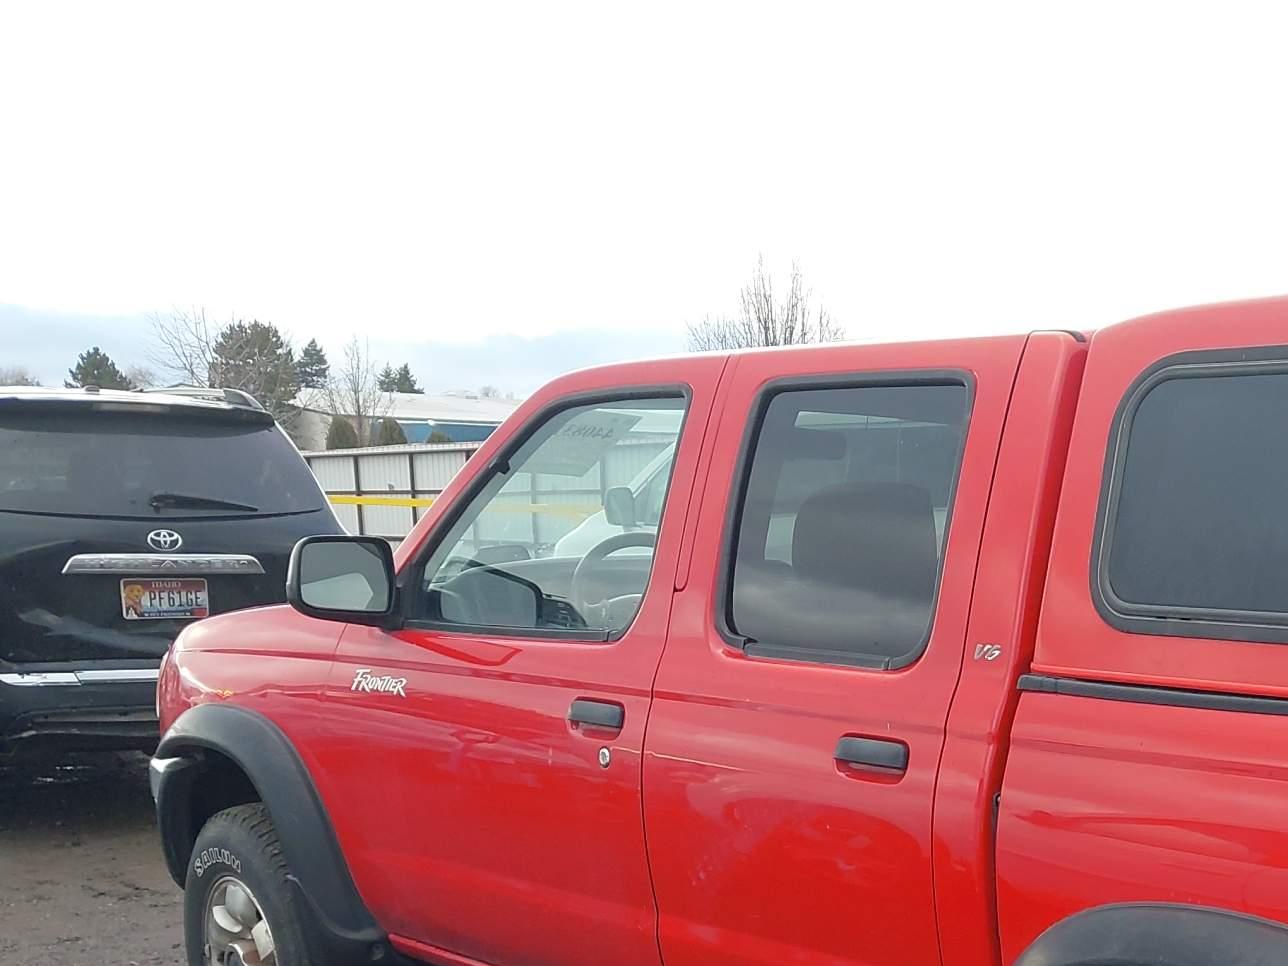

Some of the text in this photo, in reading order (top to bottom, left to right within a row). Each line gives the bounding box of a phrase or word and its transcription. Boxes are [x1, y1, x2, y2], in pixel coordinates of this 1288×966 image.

[151, 581, 182, 589] IDAHO
[974, 643, 1001, 661] V6
[194, 847, 241, 877] SAILUN
